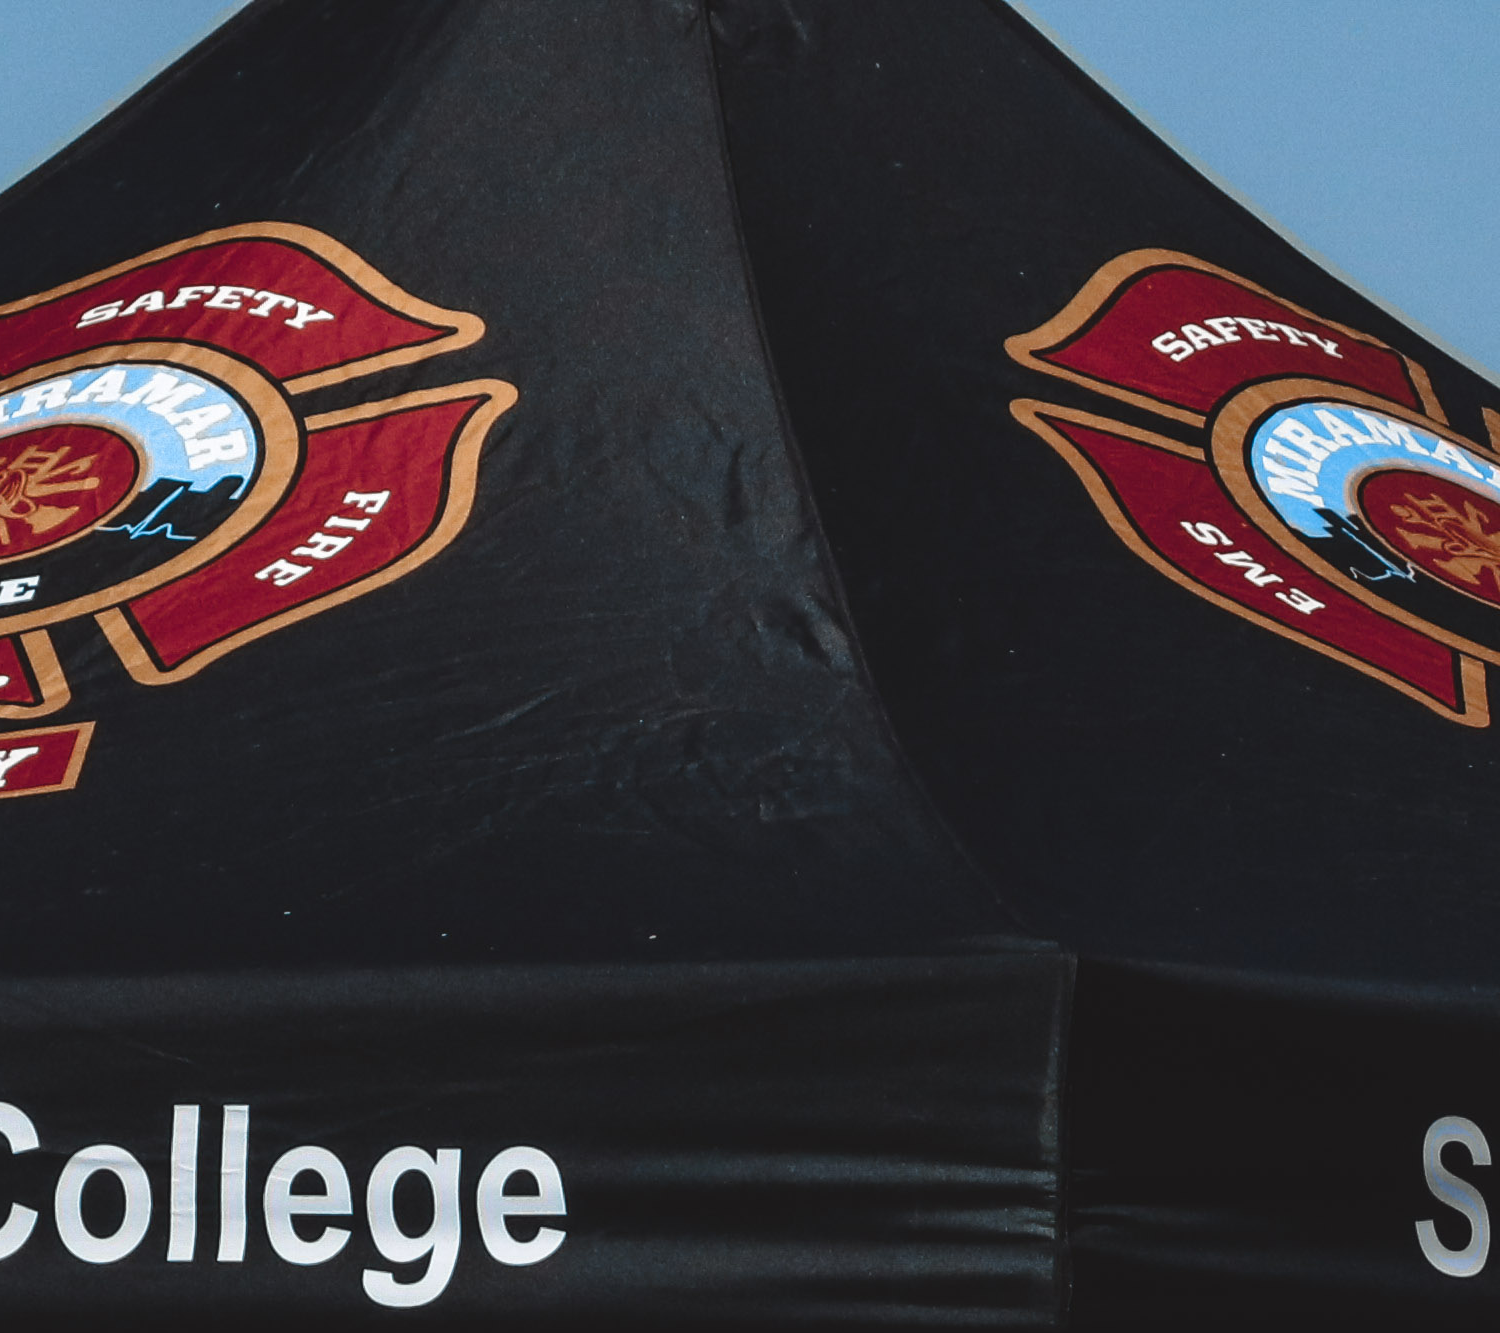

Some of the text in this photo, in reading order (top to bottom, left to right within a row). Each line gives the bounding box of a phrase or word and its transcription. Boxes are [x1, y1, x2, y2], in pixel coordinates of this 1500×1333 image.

[75, 285, 336, 333] SAFETY
[1150, 316, 1345, 363] SAFETY
[254, 488, 391, 590] FIRE
[1180, 517, 1327, 617] EMS
